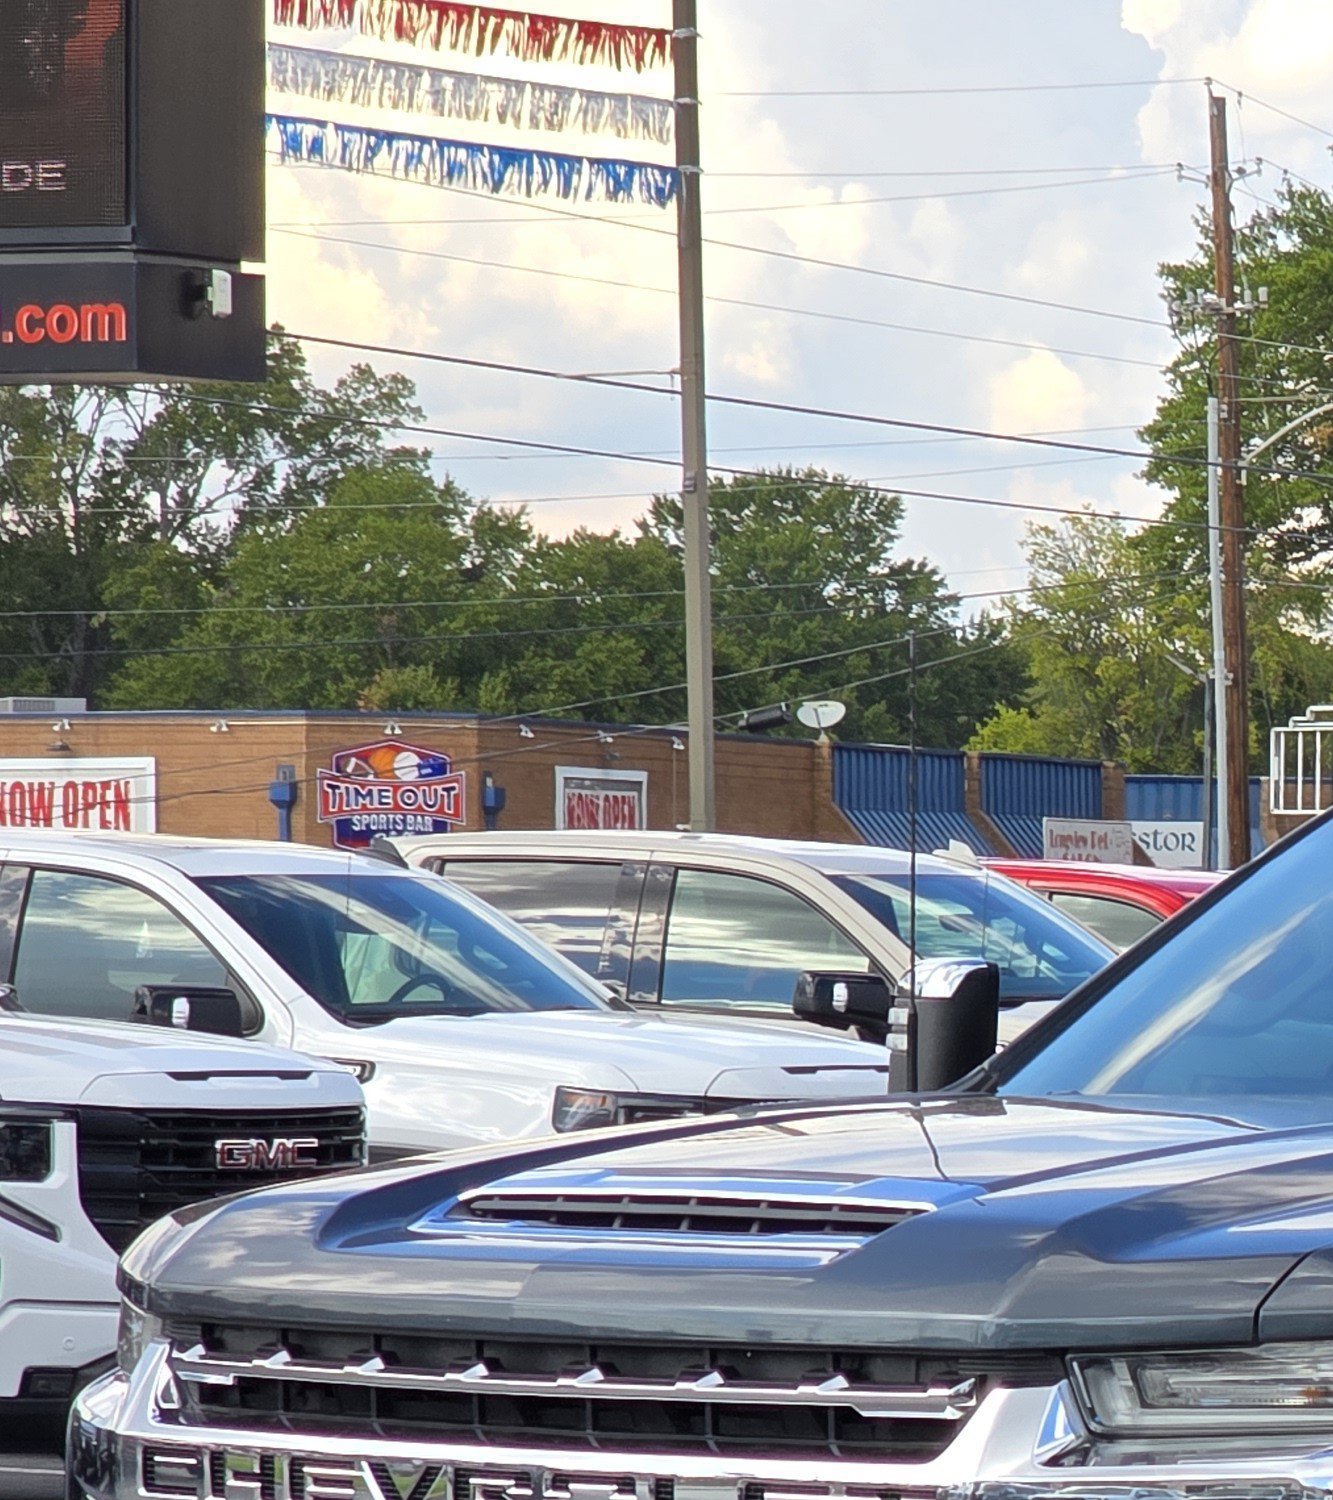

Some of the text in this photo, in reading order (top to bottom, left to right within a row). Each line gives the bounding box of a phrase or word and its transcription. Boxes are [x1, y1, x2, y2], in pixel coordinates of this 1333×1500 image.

[2, 302, 127, 343] .com
[62, 780, 132, 832] OPEN
[323, 779, 459, 815] TIME OUT
[351, 814, 434, 832] SPORTS BAR
[214, 1138, 319, 1169] GMC
